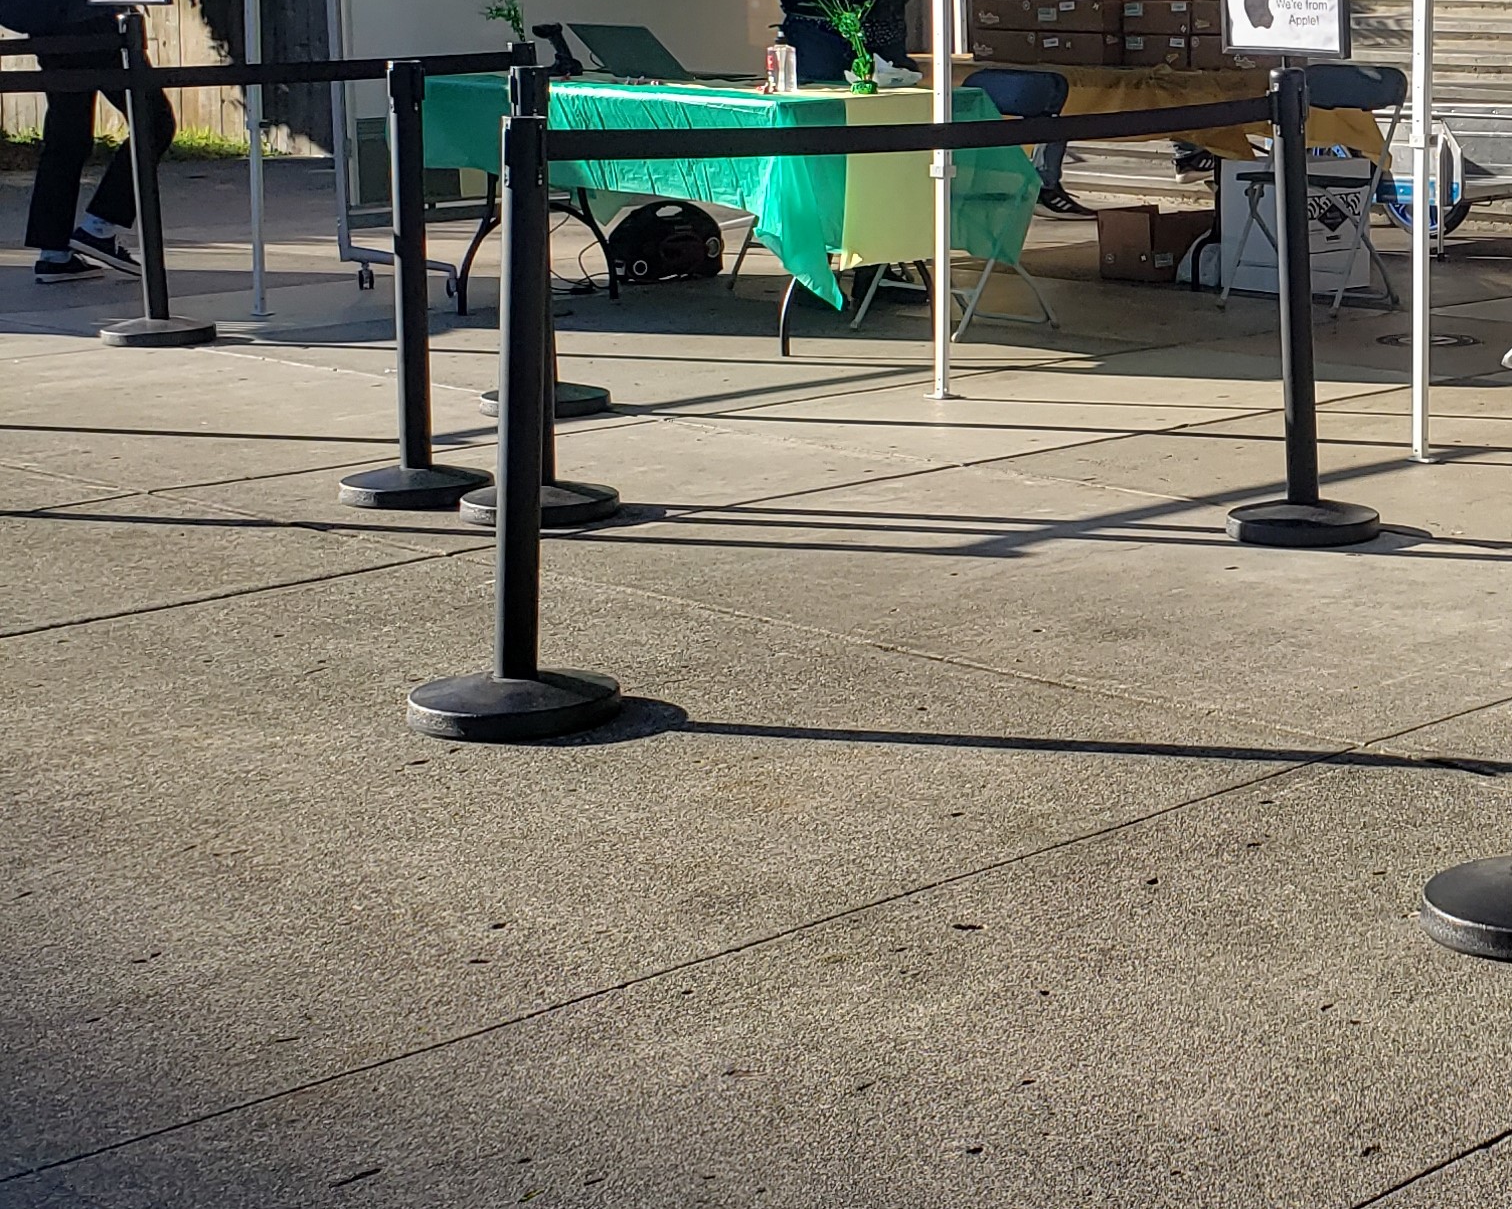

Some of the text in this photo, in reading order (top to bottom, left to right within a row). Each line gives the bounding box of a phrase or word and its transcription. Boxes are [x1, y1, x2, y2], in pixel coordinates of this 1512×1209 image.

[1276, 0, 1328, 10] We're from
[1288, 15, 1320, 27] Apple!
